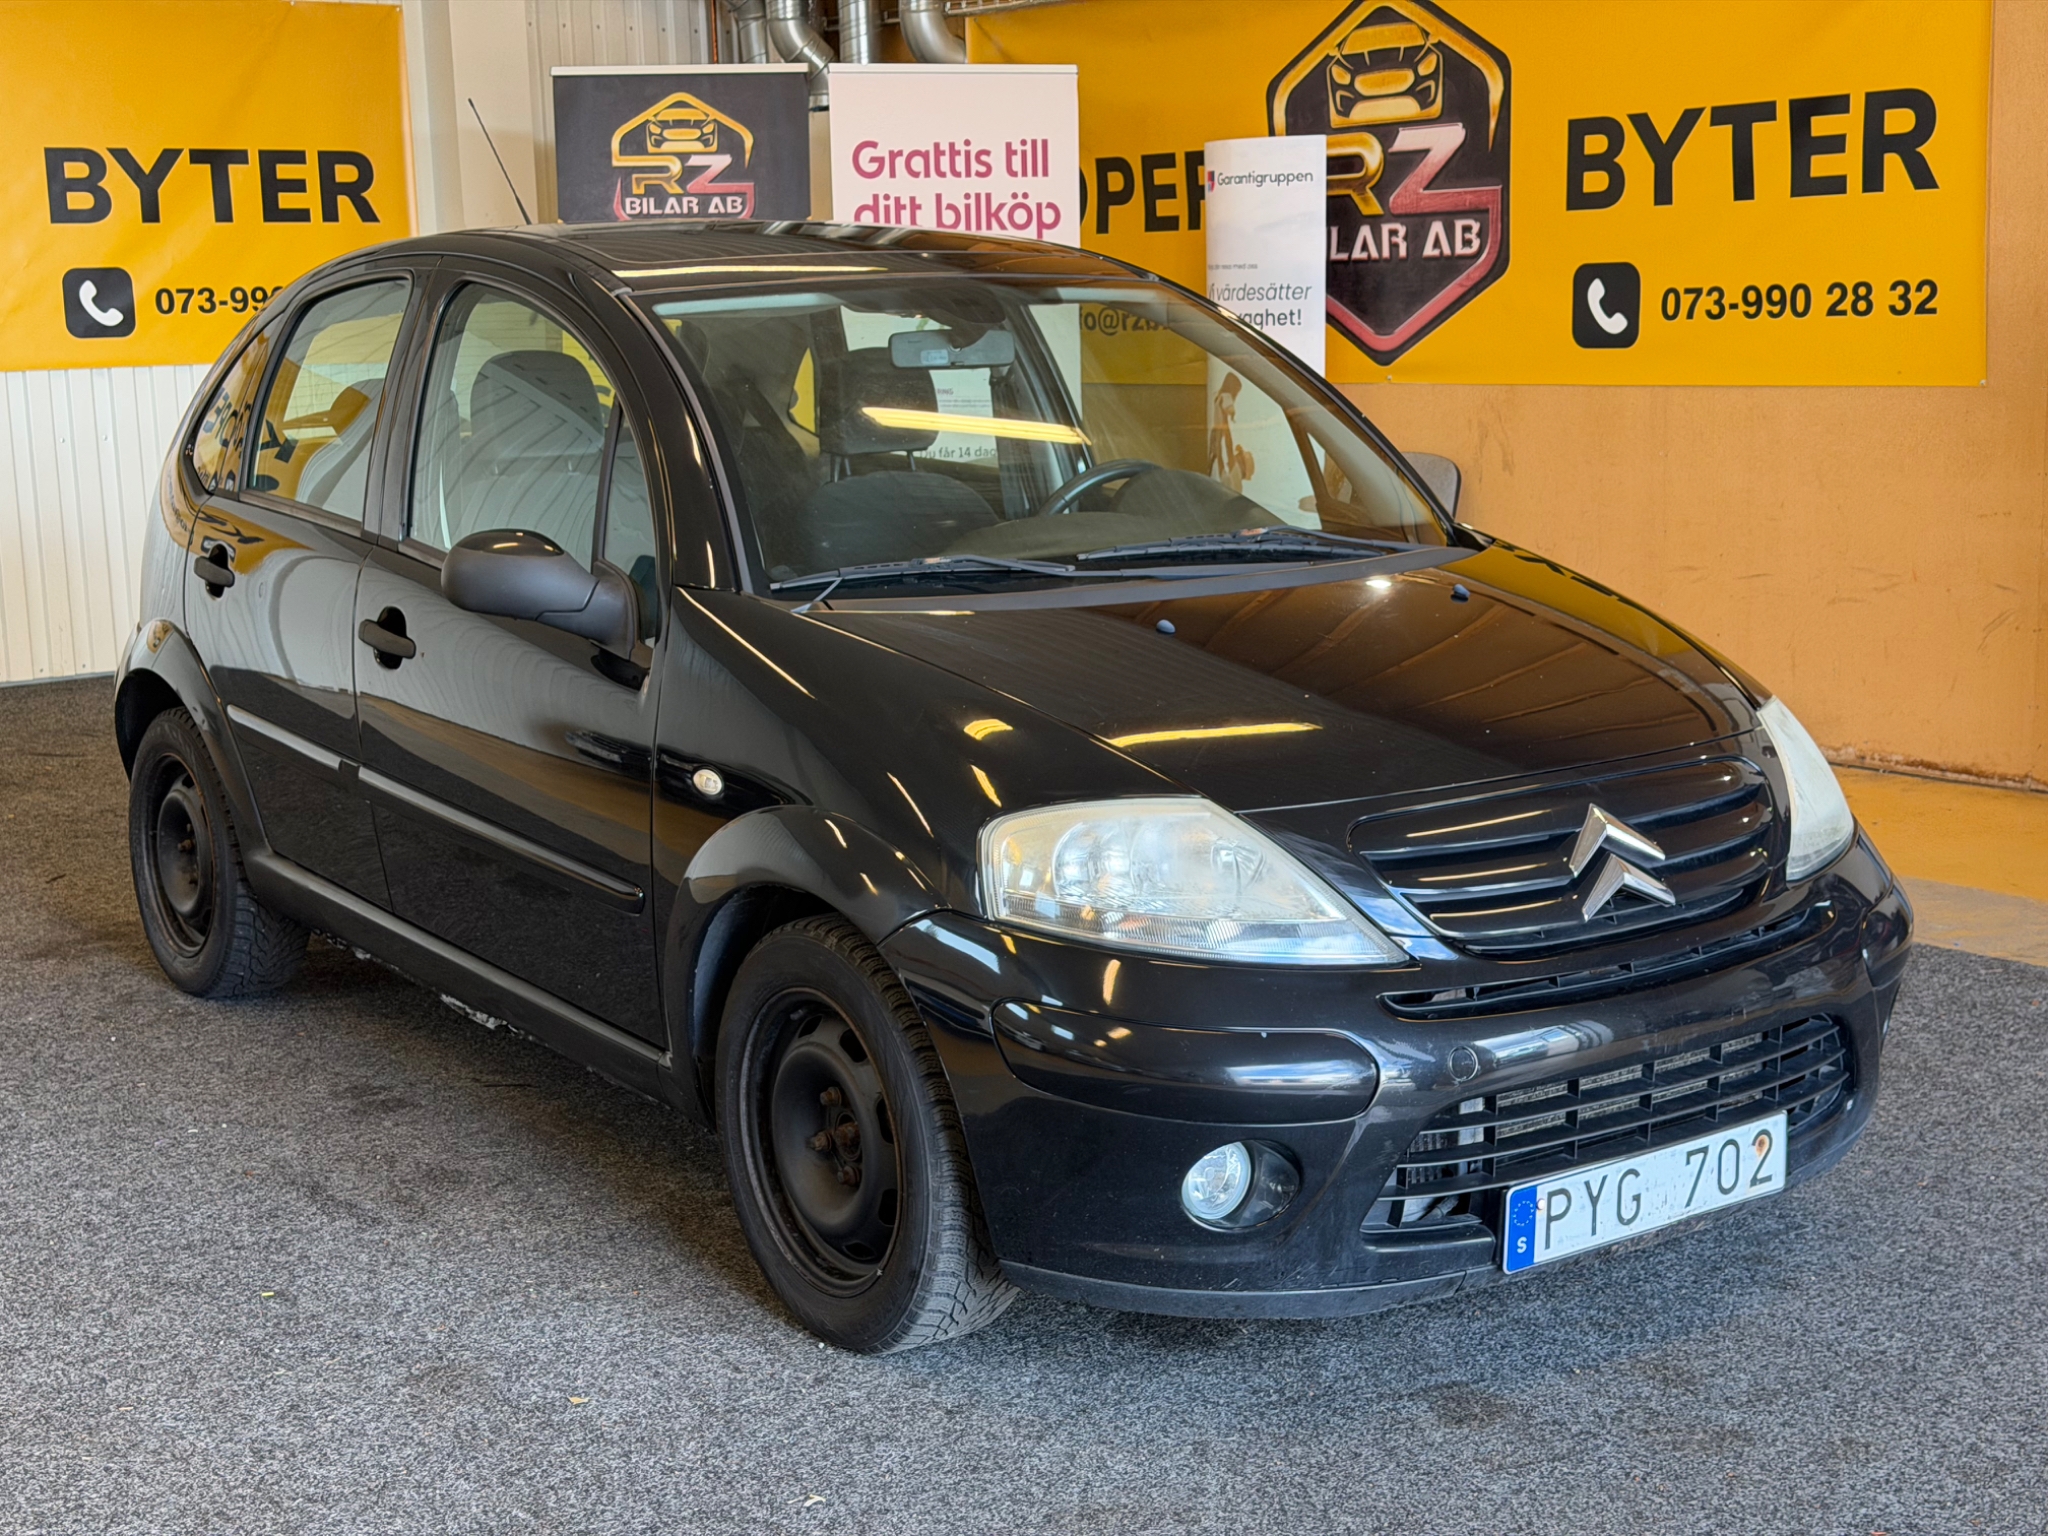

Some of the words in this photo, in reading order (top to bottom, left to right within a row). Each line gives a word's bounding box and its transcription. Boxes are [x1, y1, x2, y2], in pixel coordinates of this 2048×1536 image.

[852, 139, 993, 179] Grattis
[1005, 138, 1049, 178] till
[1566, 88, 1940, 211] BYTER
[43, 146, 380, 224] BYTER
[1079, 150, 1205, 234] PE
[1217, 170, 1314, 188] Garantigruppen
[625, 196, 699, 215] BILAR
[708, 196, 743, 215] AB
[854, 193, 922, 226] ditt
[935, 192, 1061, 239] bilköp
[1329, 222, 1408, 262] LAR
[1422, 219, 1481, 259] AB
[155, 286, 284, 315] 073-99
[1216, 283, 1312, 301] värdesätter
[1660, 282, 1812, 321] 073-990
[1826, 281, 1874, 317] 28
[1888, 279, 1939, 316] 32
[939, 447, 955, 458] får
[958, 446, 971, 458] 14
[1544, 1168, 1642, 1251] PYG
[1685, 1128, 1773, 1209] 702
[1516, 1236, 1527, 1254] S
